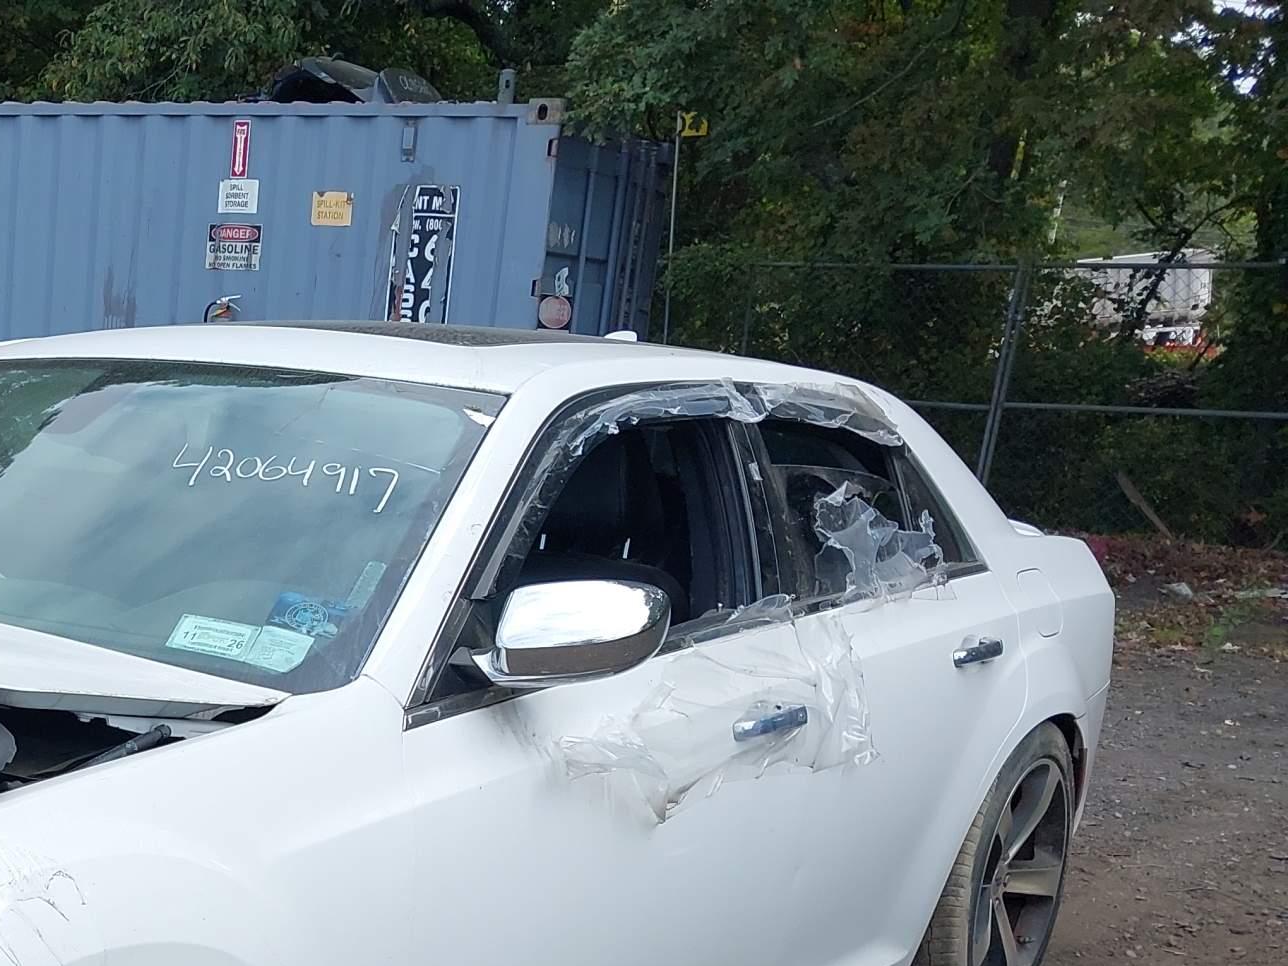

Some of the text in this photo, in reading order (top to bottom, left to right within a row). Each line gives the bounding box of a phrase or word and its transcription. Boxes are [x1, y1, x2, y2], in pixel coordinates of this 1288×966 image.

[225, 192, 249, 200] SORBENT
[317, 211, 344, 219] STATION
[209, 243, 260, 255] GASOLINE
[172, 442, 400, 514] 42064917
[227, 639, 245, 650] 26
